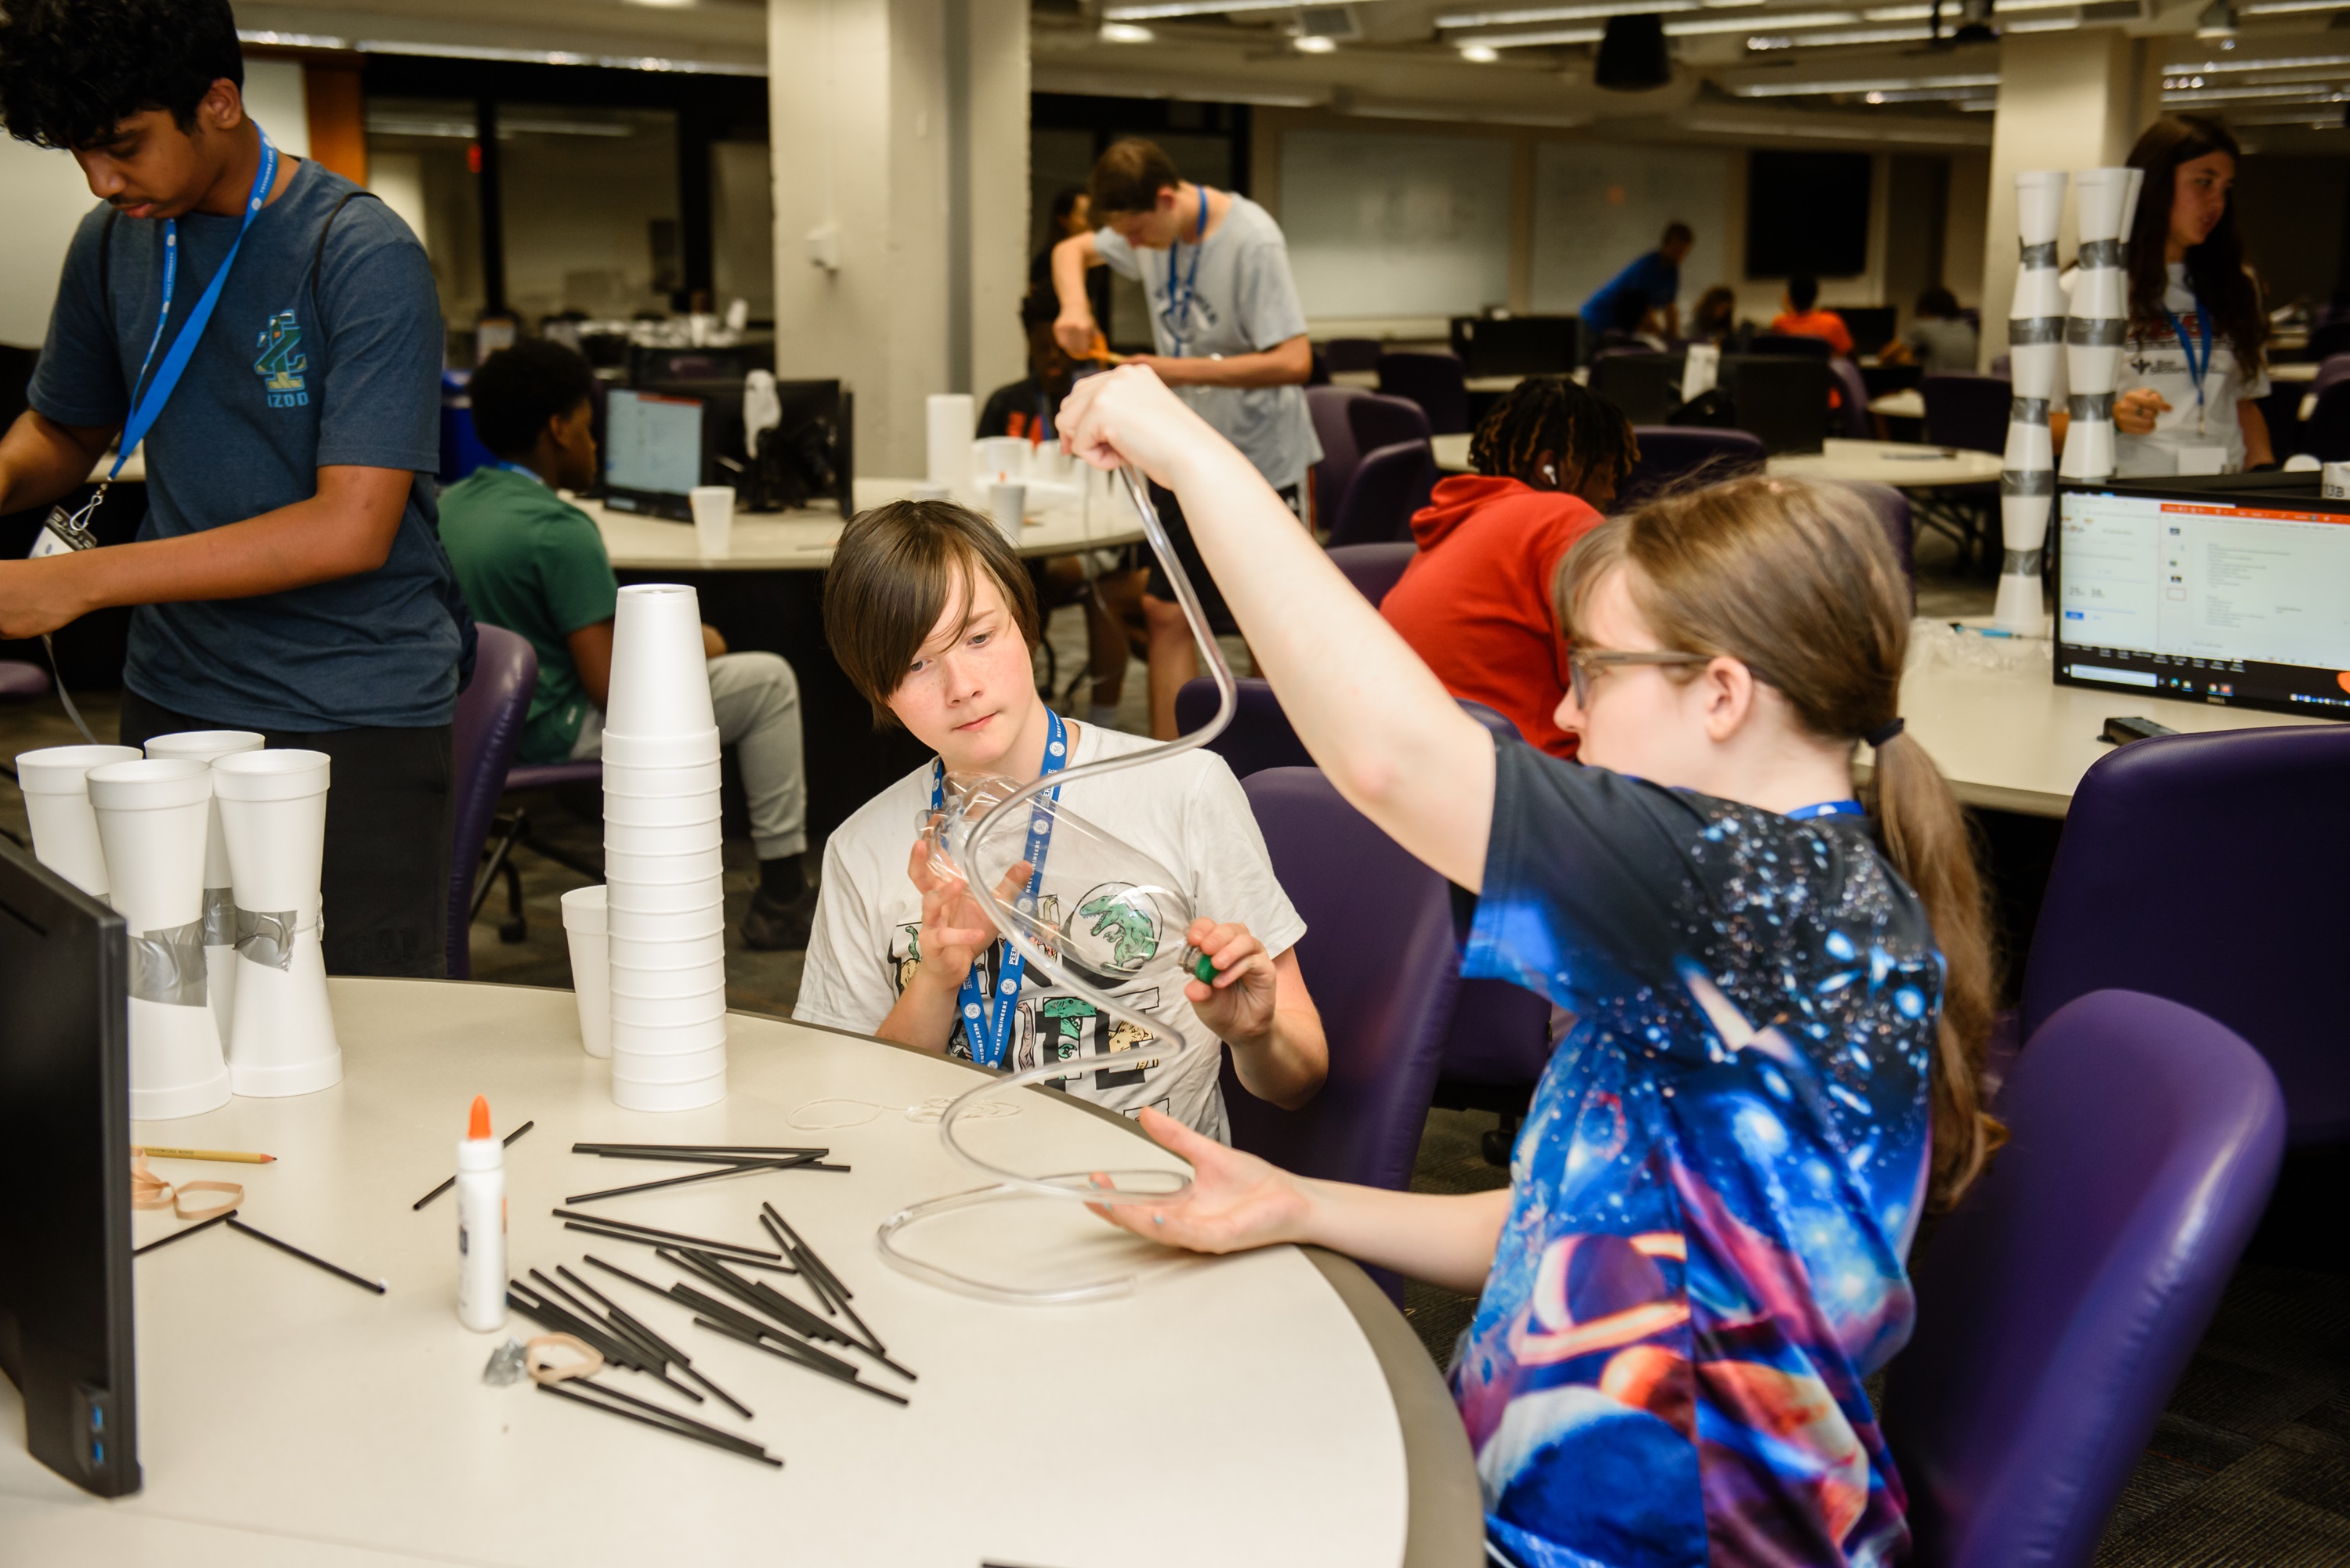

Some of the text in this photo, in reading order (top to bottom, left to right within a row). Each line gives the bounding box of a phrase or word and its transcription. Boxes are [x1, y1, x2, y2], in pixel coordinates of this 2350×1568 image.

[267, 392, 309, 407] IZOD
[997, 1000, 1008, 1037] ENGINEERS
[973, 1023, 982, 1039] NEXT
